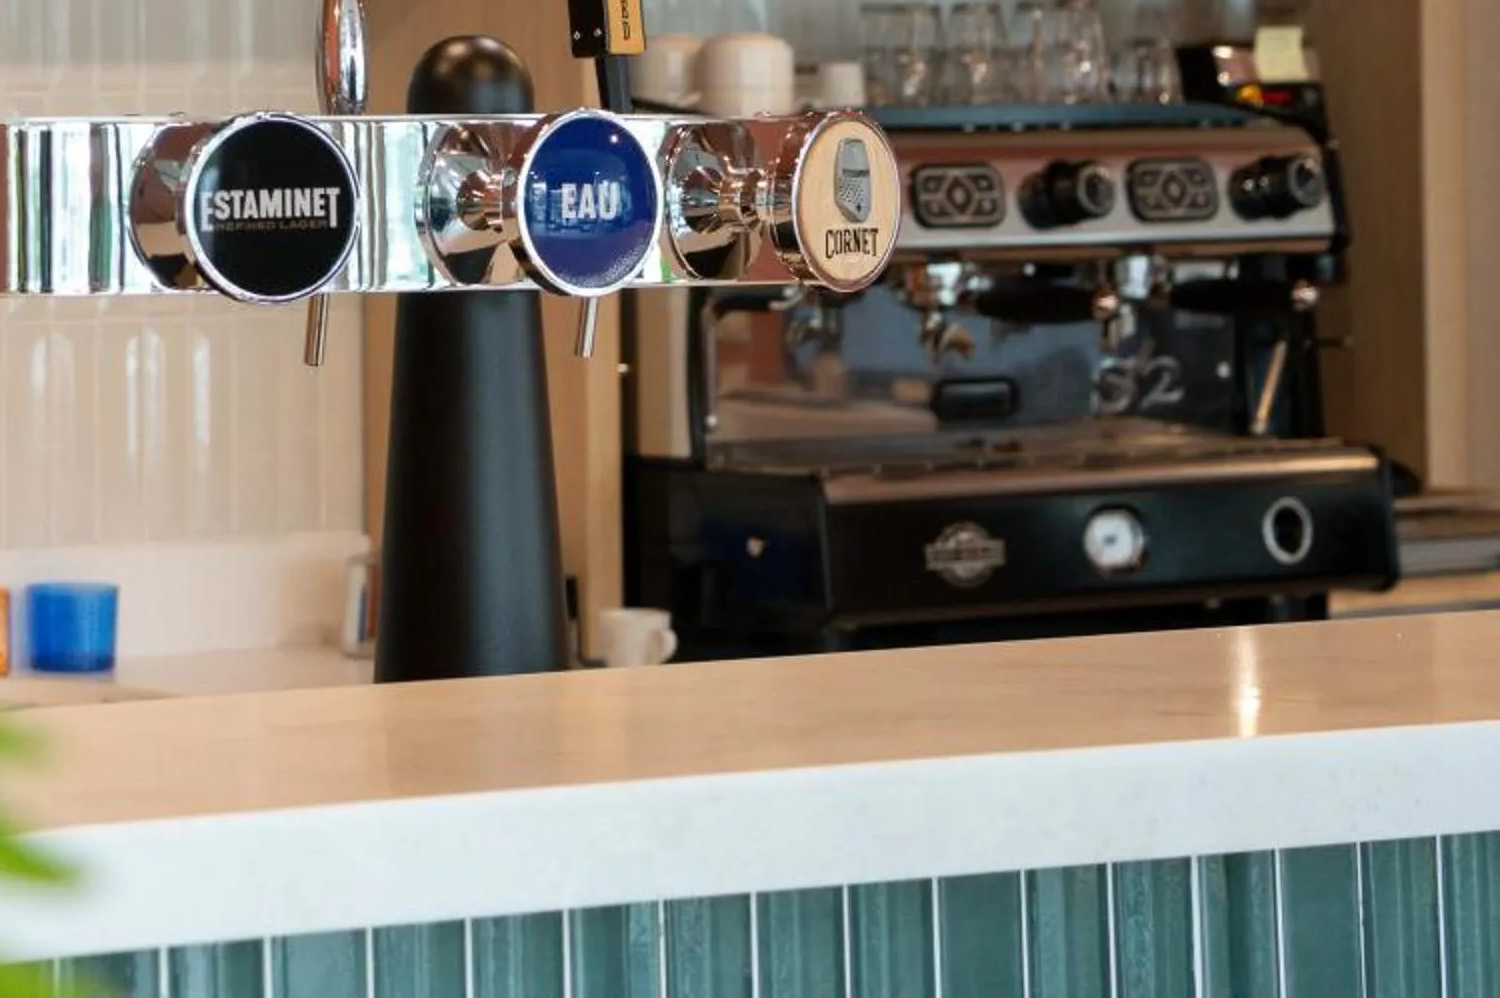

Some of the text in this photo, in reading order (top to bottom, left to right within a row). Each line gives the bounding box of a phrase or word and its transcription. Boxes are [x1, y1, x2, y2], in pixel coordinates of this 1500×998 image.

[200, 187, 341, 232] ESTAMINET
[561, 180, 620, 220] EAU
[825, 227, 879, 259] CORNET
